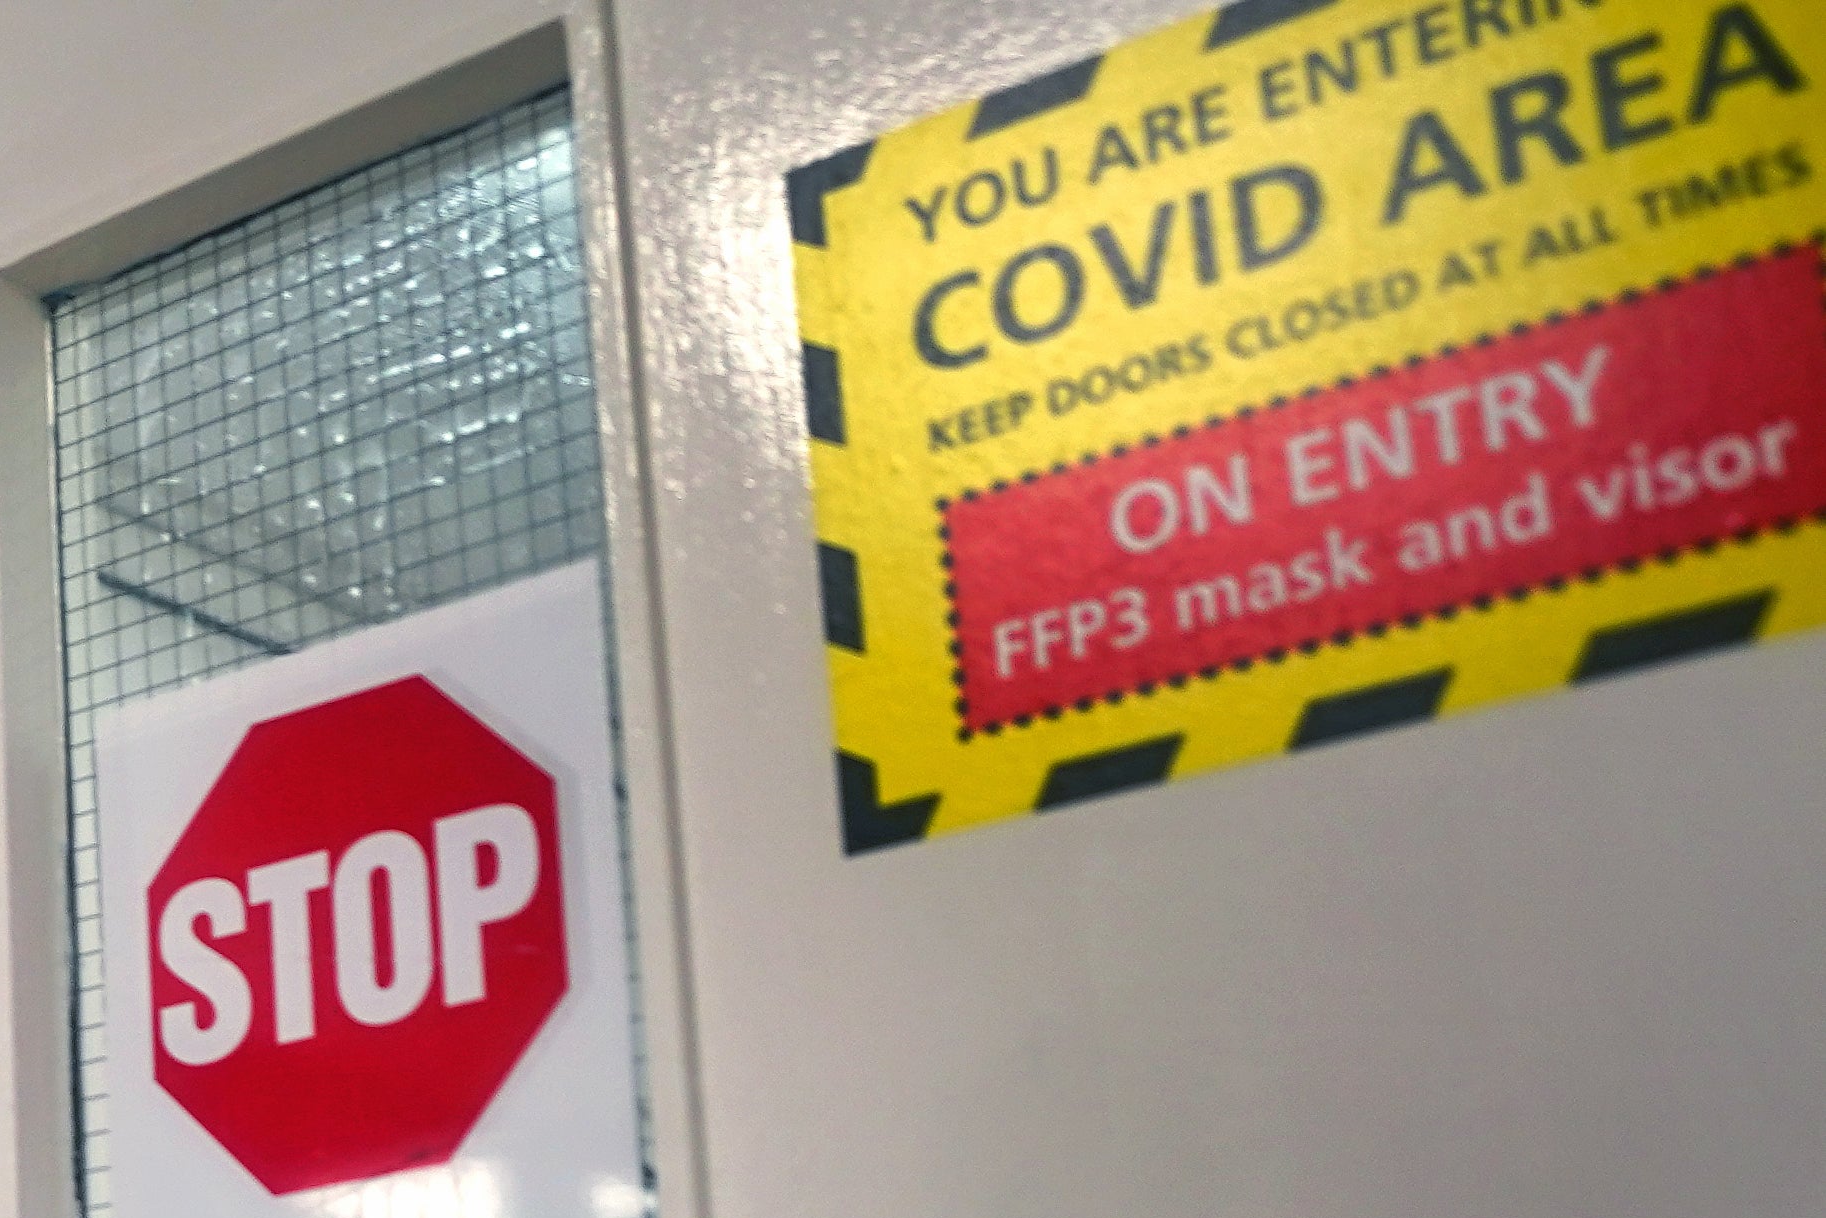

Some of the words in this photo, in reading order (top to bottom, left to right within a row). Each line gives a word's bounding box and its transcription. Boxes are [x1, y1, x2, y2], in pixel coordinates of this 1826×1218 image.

[905, 147, 1060, 243] YOU
[1087, 83, 1231, 187] ARE
[912, 162, 1325, 370] COVID
[1381, 2, 1806, 226] AREA
[926, 391, 1033, 452] KEEP
[1046, 334, 1214, 418] DOORS
[1224, 268, 1421, 360] CLOSED
[1436, 239, 1504, 294] AT
[1523, 203, 1619, 267] ALL
[1634, 141, 1813, 227] TIMES
[992, 586, 1150, 680] FFP3
[1175, 526, 1372, 631] mask
[1396, 471, 1553, 574] and
[1578, 417, 1799, 522] visor
[1110, 453, 1254, 554] ON
[1286, 343, 1614, 506] ENTRY
[157, 802, 541, 1066] STOP
